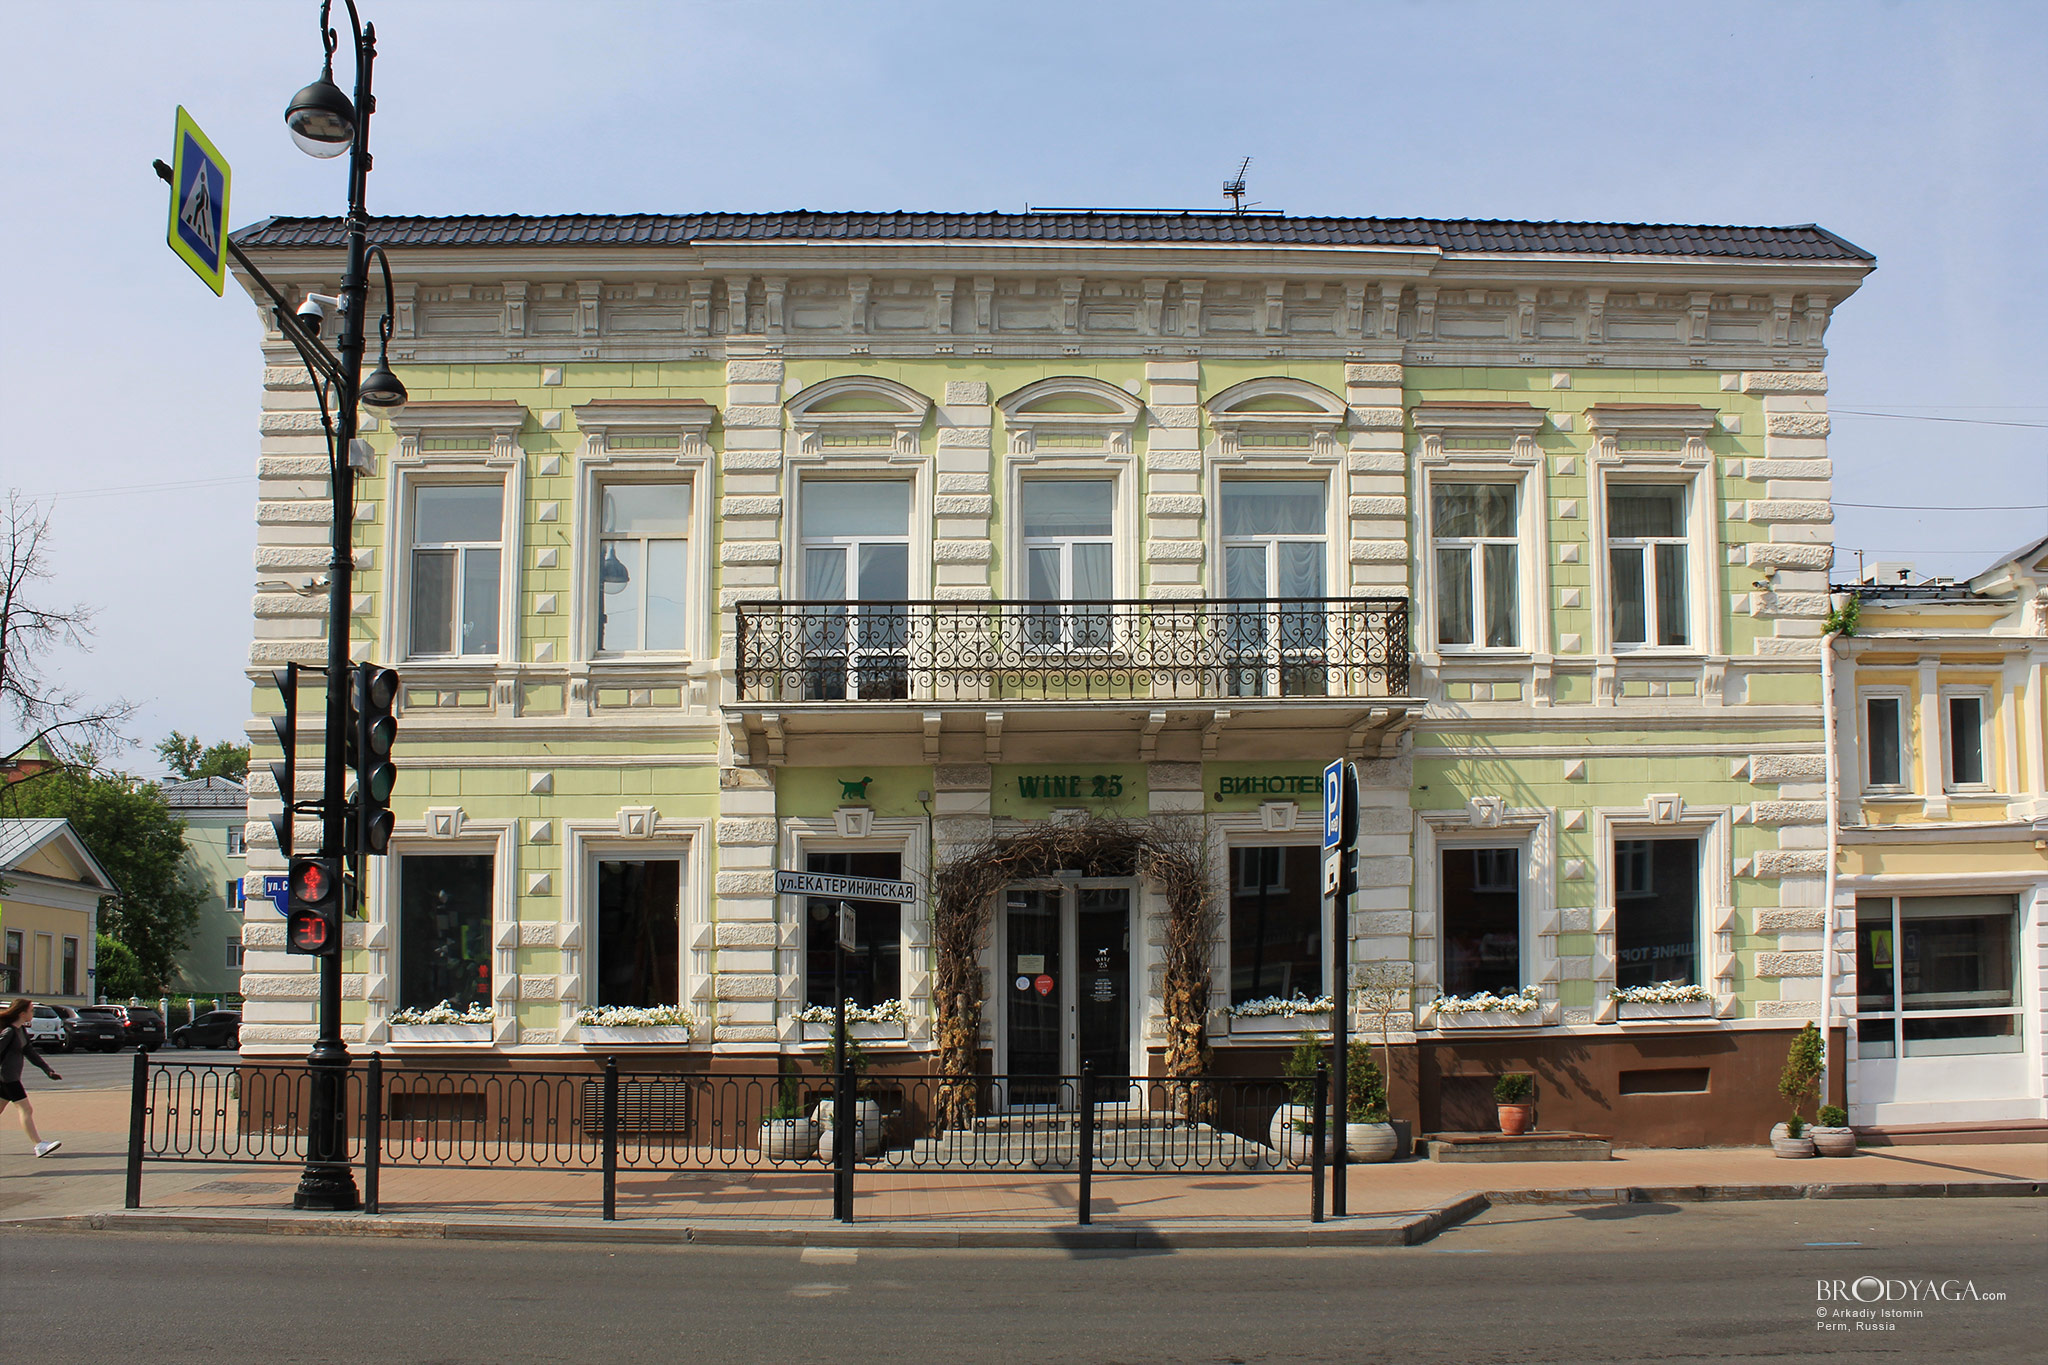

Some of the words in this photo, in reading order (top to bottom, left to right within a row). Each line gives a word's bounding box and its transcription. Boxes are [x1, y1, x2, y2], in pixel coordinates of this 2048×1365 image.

[1018, 775, 1080, 798] WINE
[1091, 775, 1123, 798] 25
[1328, 771, 1339, 837] P
[299, 917, 325, 944] 30
